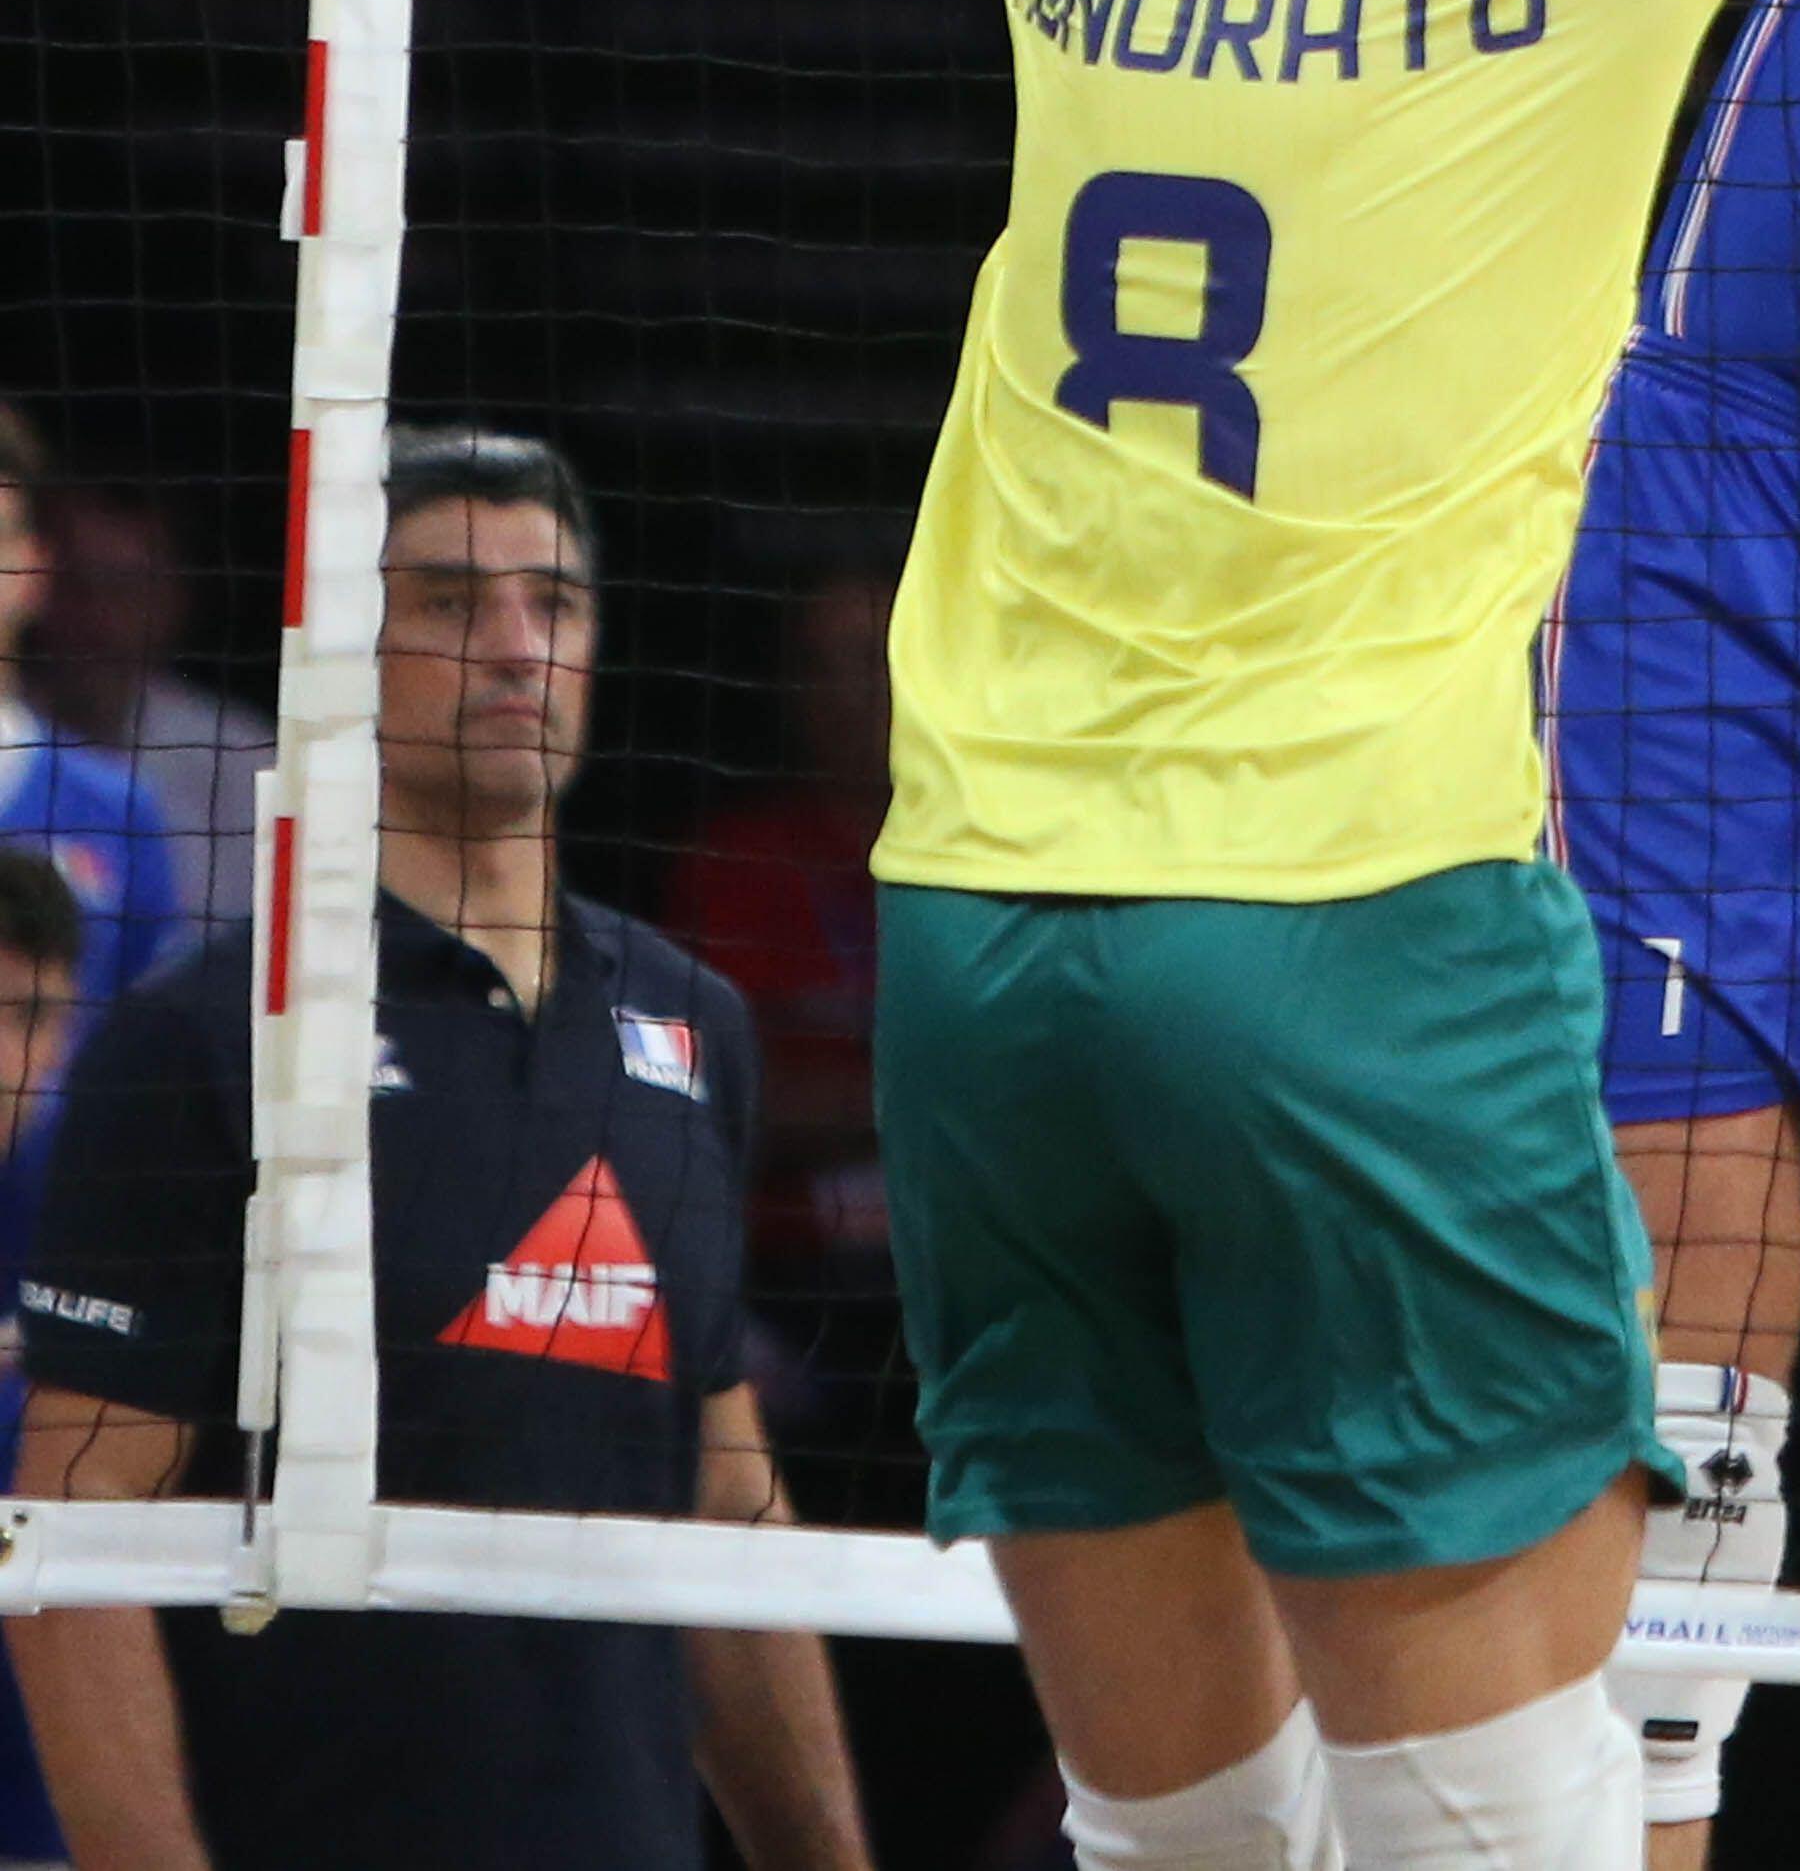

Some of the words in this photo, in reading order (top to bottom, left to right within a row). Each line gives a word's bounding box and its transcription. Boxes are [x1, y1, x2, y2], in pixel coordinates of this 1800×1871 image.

[1054, 170, 1272, 505] 8
[1641, 937, 1684, 1036] 1
[486, 1261, 657, 1329] MAIF
